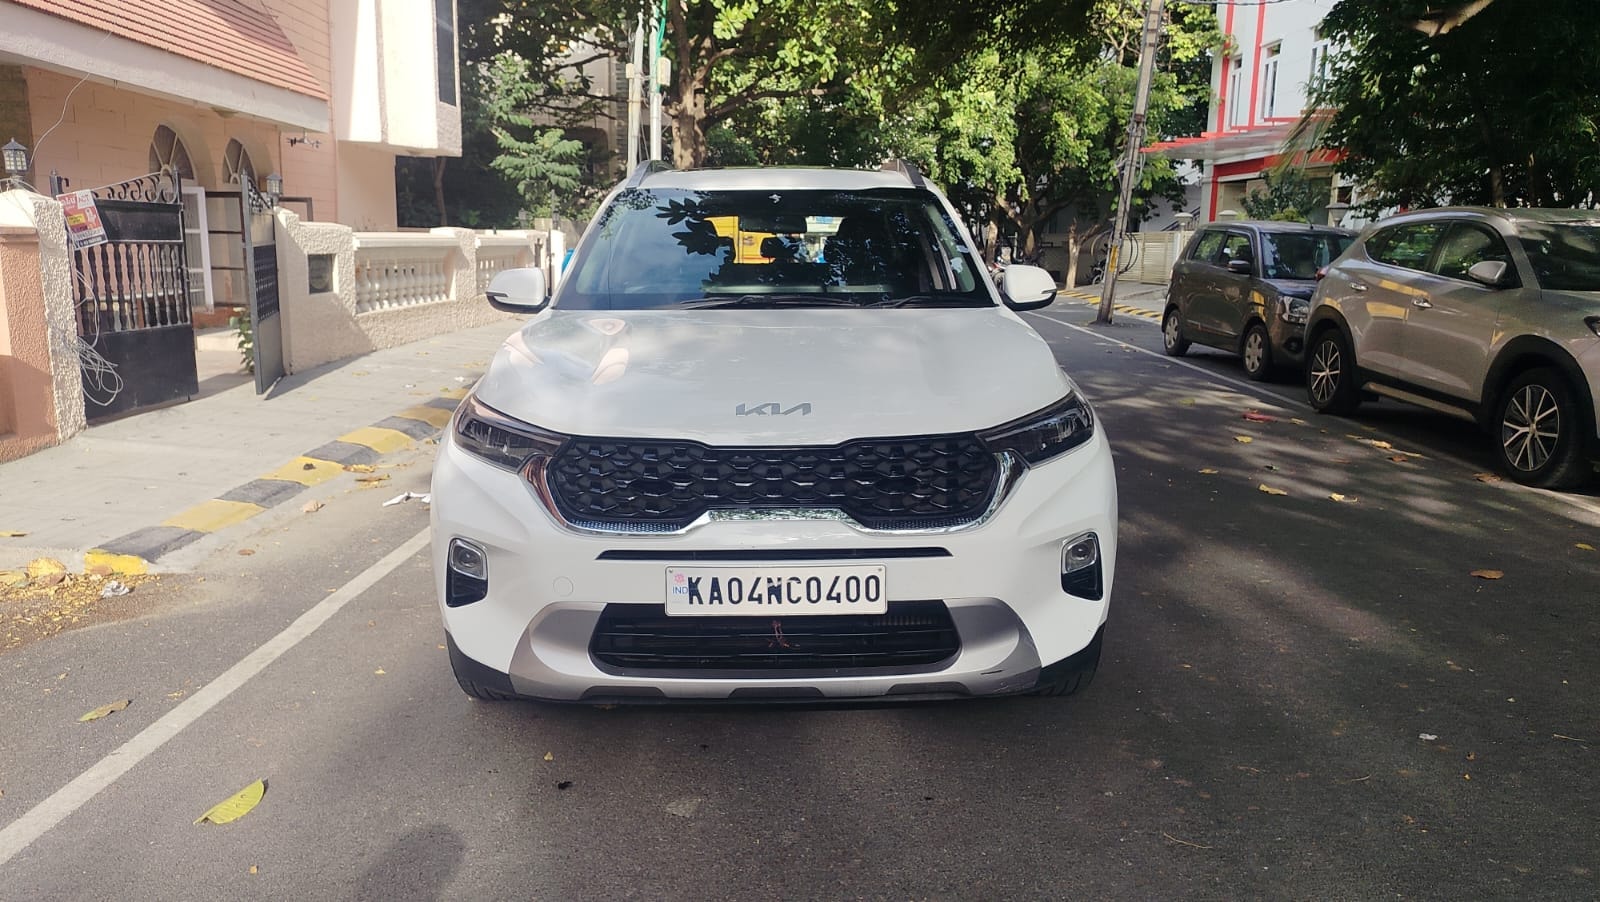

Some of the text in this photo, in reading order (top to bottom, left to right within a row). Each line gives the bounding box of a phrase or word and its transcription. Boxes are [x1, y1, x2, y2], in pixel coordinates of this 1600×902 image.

[736, 402, 811, 416] KIA
[672, 586, 688, 595] IND
[688, 575, 881, 605] KA04NC0400
